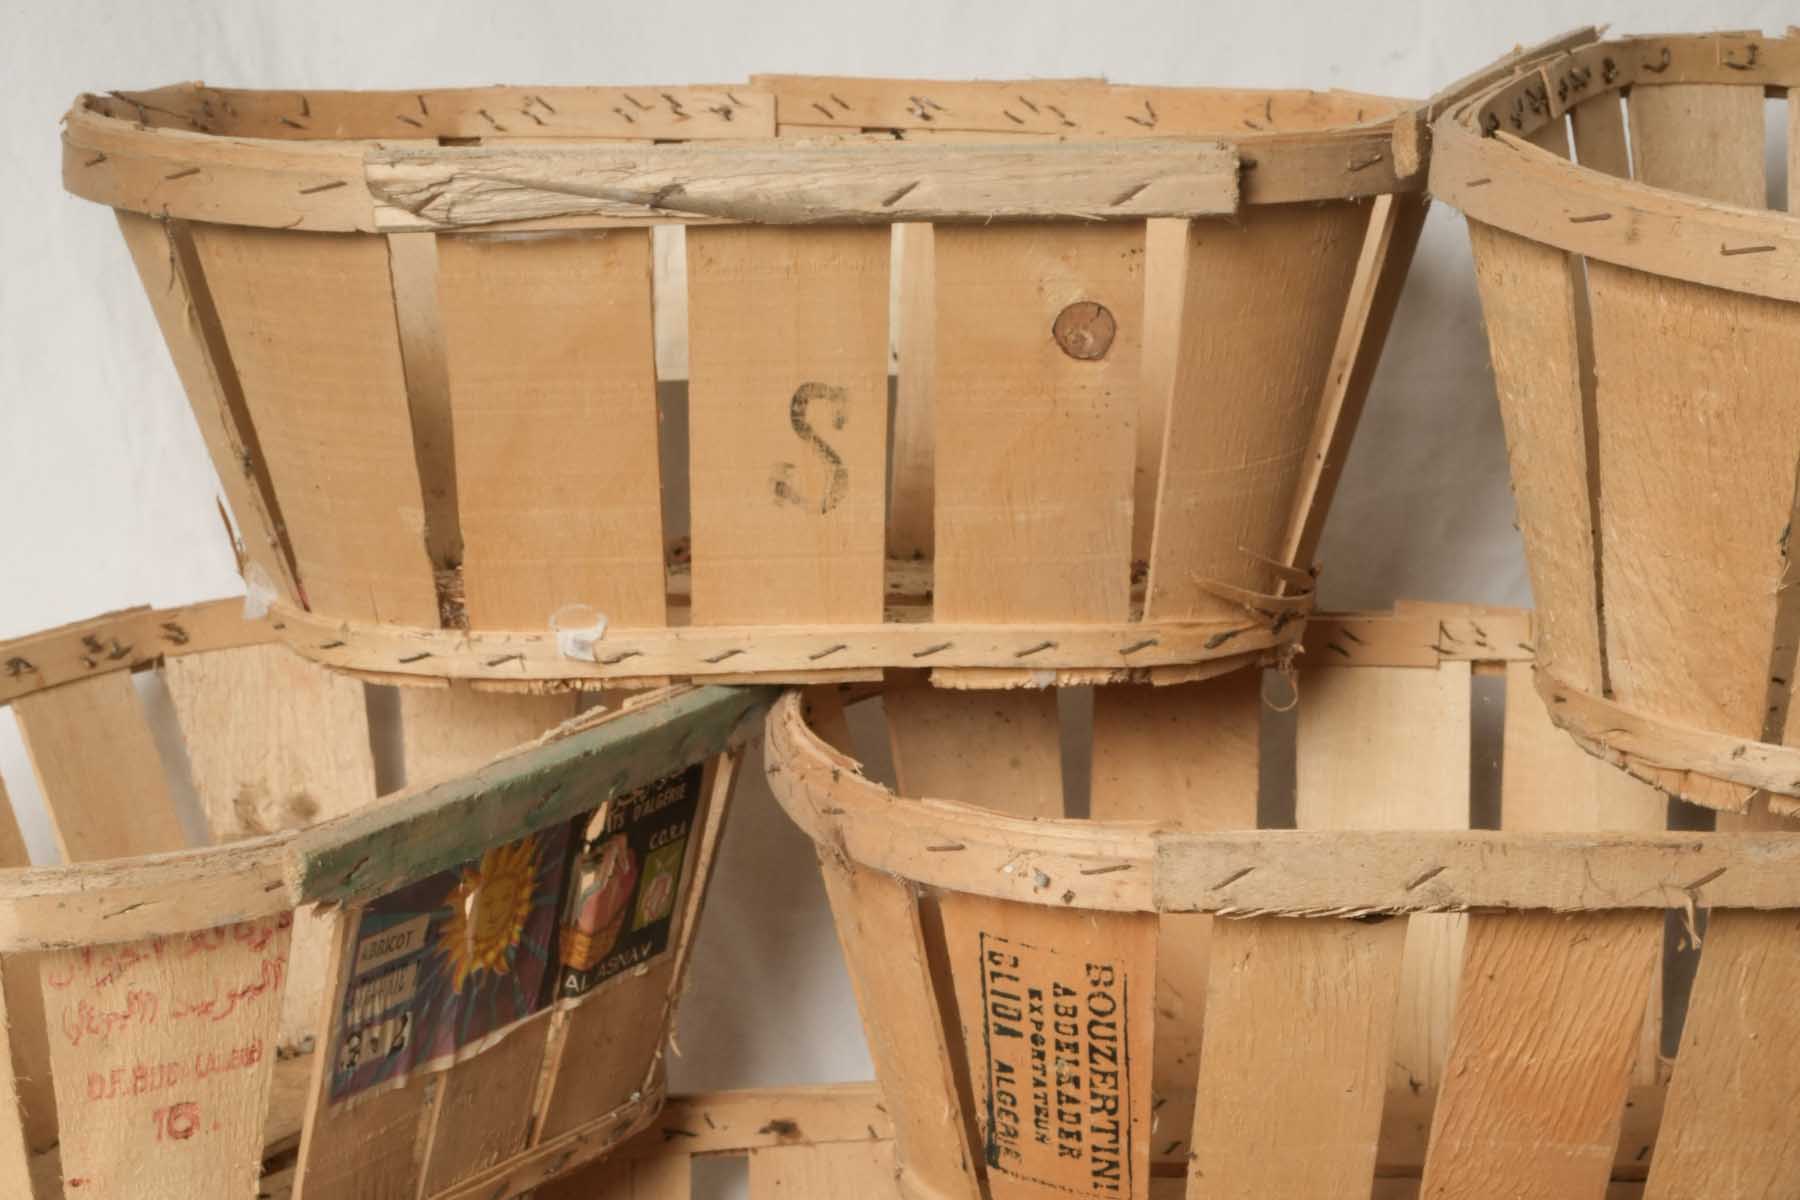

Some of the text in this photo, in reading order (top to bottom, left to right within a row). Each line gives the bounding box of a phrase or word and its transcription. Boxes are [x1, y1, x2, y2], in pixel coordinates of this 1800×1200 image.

[768, 380, 849, 517] S
[993, 1057, 1022, 1164] ALGERIE
[1027, 986, 1050, 1146] EXPORTATEUR
